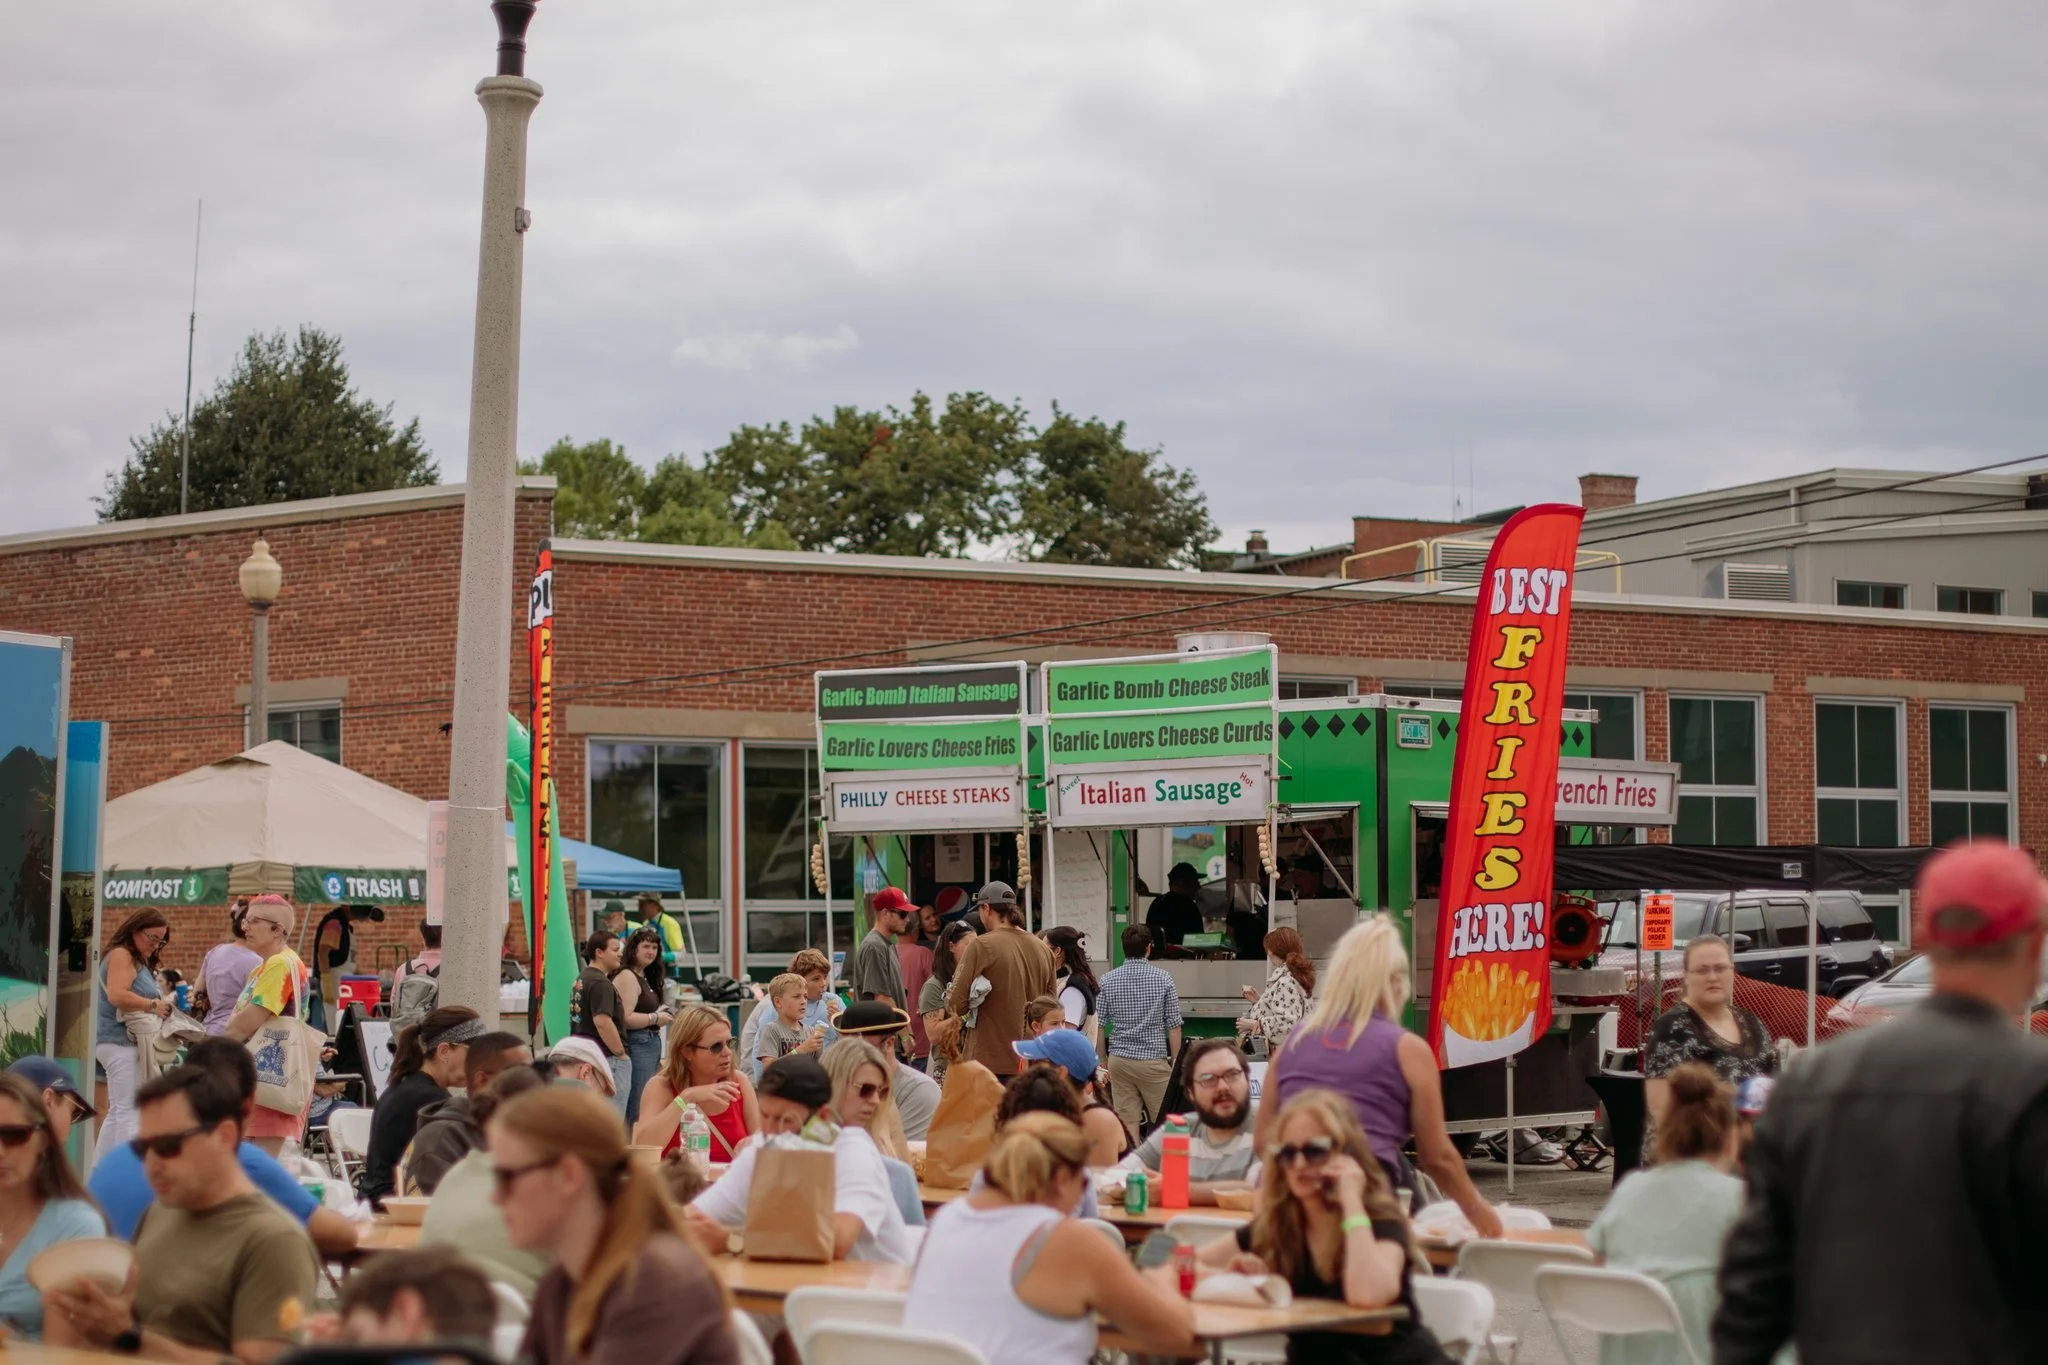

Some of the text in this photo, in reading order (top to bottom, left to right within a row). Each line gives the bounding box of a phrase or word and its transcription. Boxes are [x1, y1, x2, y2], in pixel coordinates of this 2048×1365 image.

[1490, 567, 1568, 616] BEST
[822, 682, 1018, 707] Garlic Bomb Italian Sausage
[1057, 667, 1270, 701] Garlic Bomb Cheese Steak
[827, 735, 1016, 759] Garlic Lovers Cheese Fries
[1053, 720, 1273, 753] Garlic Lovers Cheese Curds
[1474, 625, 1544, 891] FRIES
[1060, 775, 1081, 795] Sweet
[1080, 778, 1242, 805] Italian Sausage
[1239, 771, 1254, 788] Hot
[1555, 775, 1657, 808] rench Fries
[840, 787, 1011, 808] PHILLY CHEESE STEAKS
[104, 879, 183, 899] COMPOST
[346, 877, 404, 898] TRASH
[1449, 901, 1545, 959] HERE!
